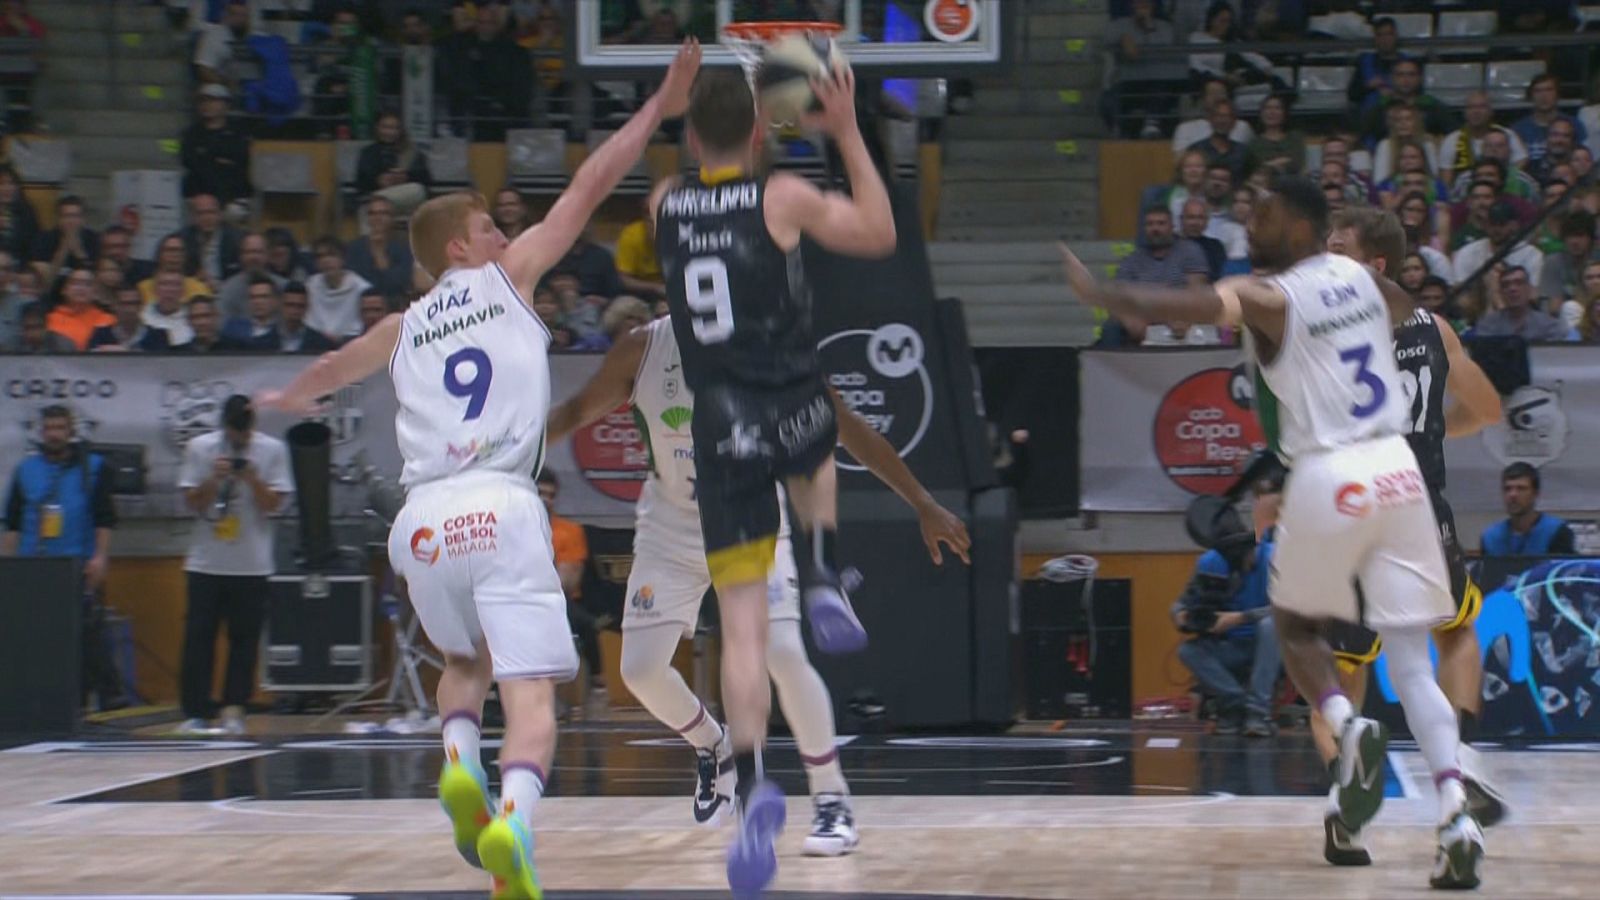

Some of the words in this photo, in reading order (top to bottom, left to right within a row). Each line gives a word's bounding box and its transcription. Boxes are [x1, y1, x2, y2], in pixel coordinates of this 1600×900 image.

[427, 287, 472, 321] DÍAZ
[684, 255, 735, 345] 9
[414, 302, 505, 348] BENAHAVÍS
[8, 379, 116, 399] CAZOO
[443, 347, 493, 422] 9
[1337, 343, 1387, 418] 3
[837, 390, 885, 409] opa
[593, 425, 641, 445] Cop
[1175, 421, 1241, 441] Copa
[443, 511, 497, 532] COSTA
[444, 530, 468, 546] DEL
[470, 526, 497, 539] SOL
